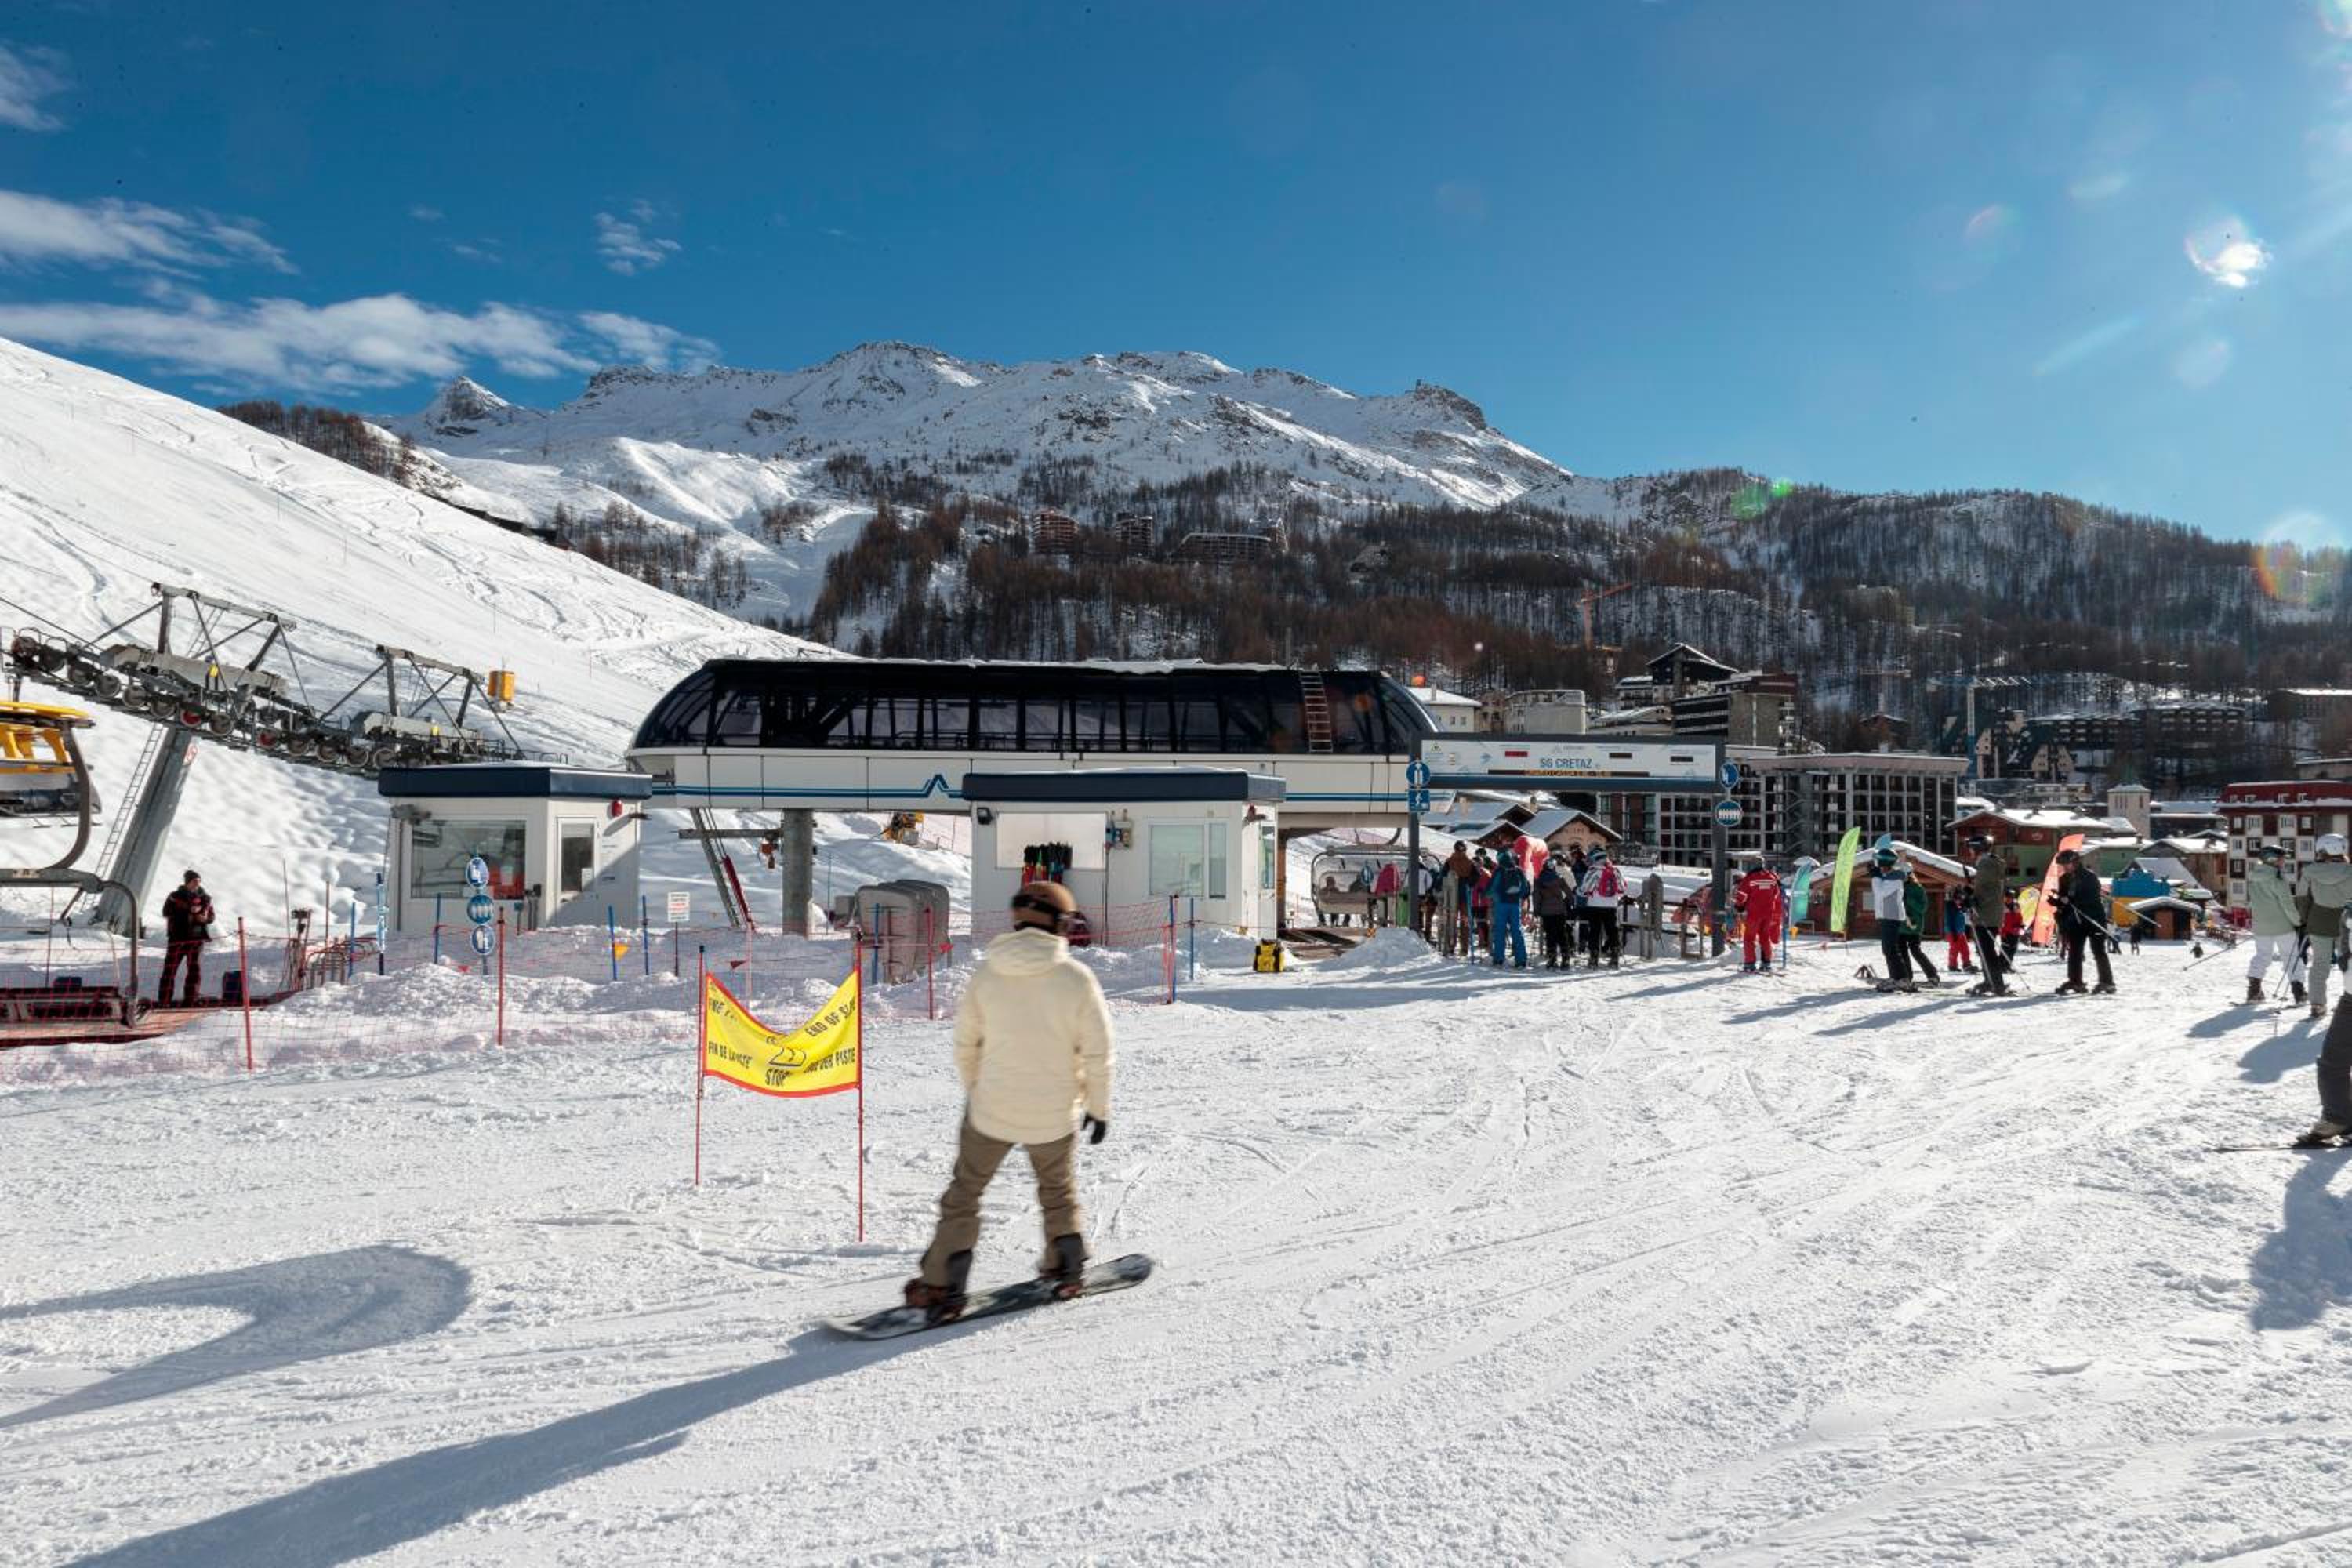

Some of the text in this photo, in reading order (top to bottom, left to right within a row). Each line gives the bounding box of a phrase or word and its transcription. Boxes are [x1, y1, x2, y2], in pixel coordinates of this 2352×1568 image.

[1540, 758, 1592, 768] SG CRETAZ
[805, 1022, 828, 1036] END
[825, 1012, 840, 1025] OF
[836, 1047, 855, 1066] PISTE
[765, 1067, 789, 1087] STOP
